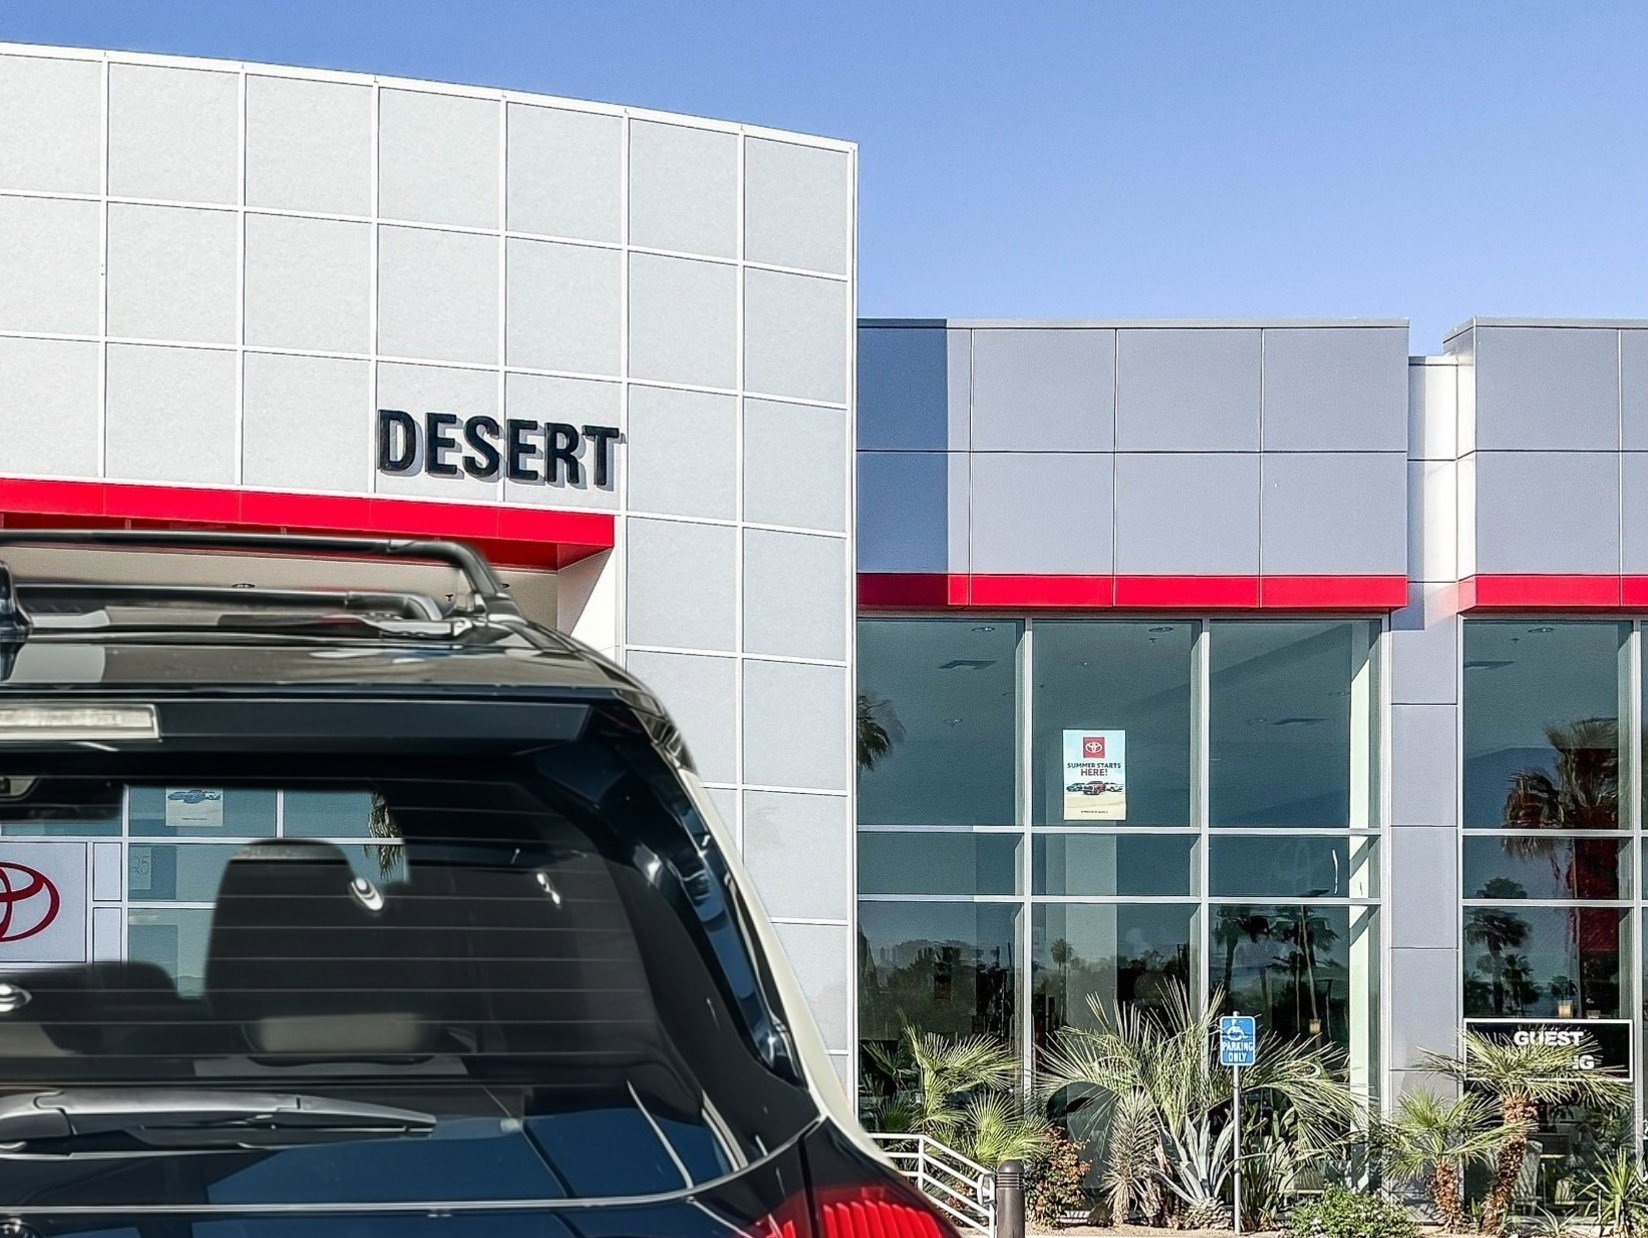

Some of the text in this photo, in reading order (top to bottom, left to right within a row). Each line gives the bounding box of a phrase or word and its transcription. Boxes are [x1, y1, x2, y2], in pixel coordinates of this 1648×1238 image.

[377, 409, 620, 486] DESERT
[1513, 1031, 1584, 1046] GUEST
[1222, 1041, 1254, 1051] PARKING
[1228, 1052, 1248, 1062] ONLY
